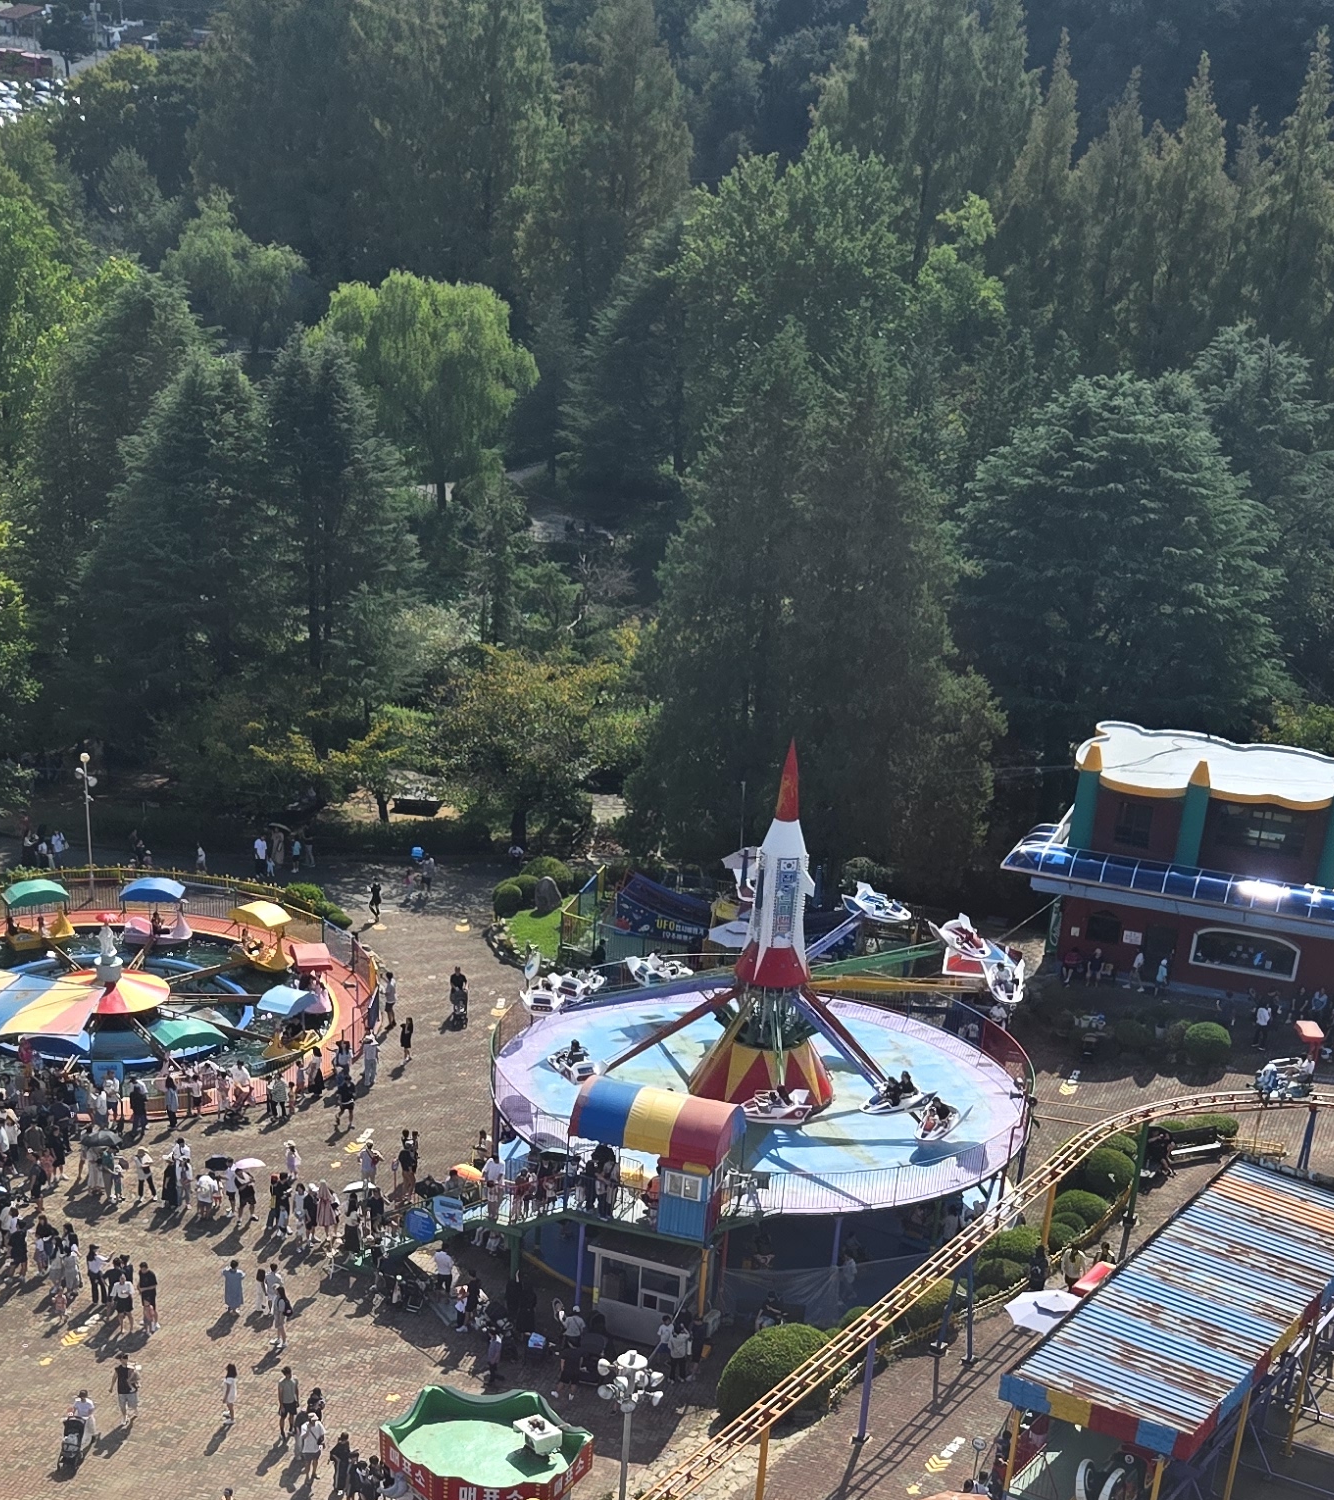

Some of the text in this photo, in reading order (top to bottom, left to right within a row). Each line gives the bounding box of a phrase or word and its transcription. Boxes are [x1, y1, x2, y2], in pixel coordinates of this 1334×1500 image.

[656, 918, 675, 931] UFO
[388, 1446, 426, 1488] 매표소
[553, 1457, 585, 1497] 매표소
